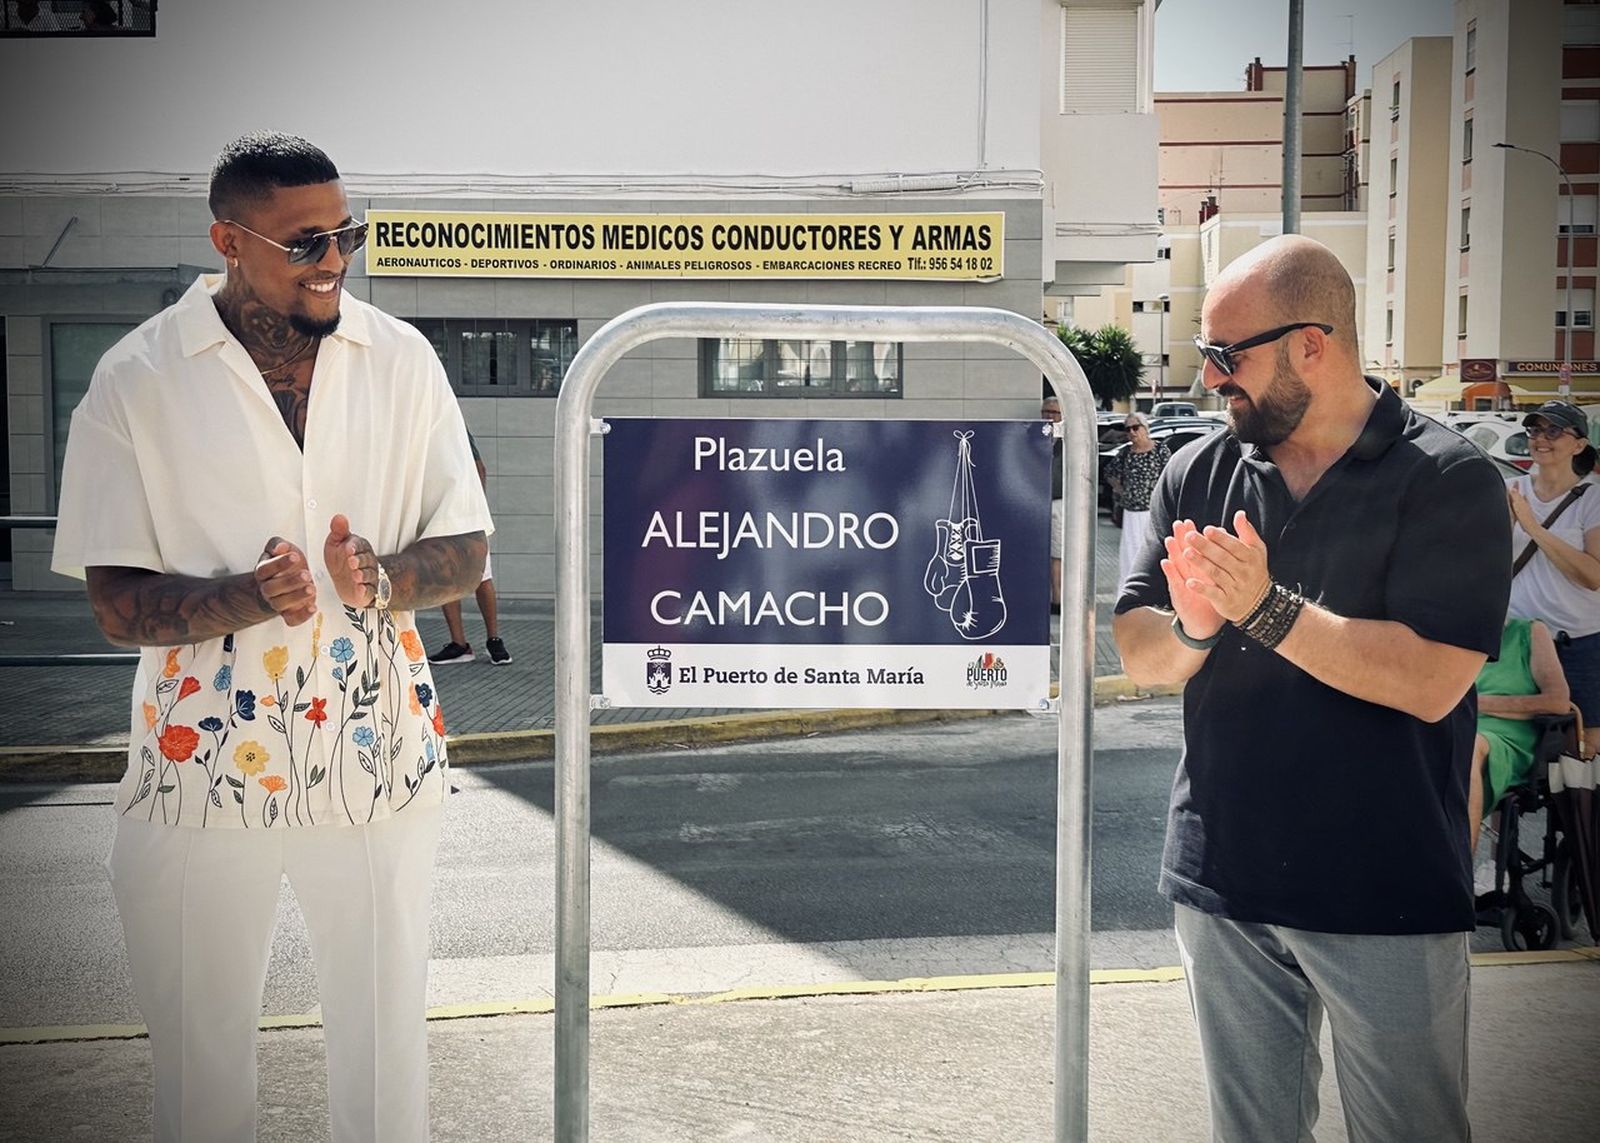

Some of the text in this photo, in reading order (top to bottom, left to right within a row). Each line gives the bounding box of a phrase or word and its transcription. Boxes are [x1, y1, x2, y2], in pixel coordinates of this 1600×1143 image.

[376, 221, 992, 251] RECONOCIMIENTOS MEDICOS CONDUCTORES Y ARMAS
[376, 257, 462, 269] AERONAUTICOS
[470, 258, 540, 270] DEPORTIVOS
[549, 259, 617, 270] ORDINARIOS
[625, 260, 682, 271] ANIMALES
[684, 260, 752, 271] PELIGROSOS
[762, 260, 855, 271] EMBARCACIONES
[858, 260, 902, 271] RECREO
[907, 256, 927, 271] Tlf.:
[928, 256, 948, 271] 956
[949, 256, 963, 271] 54
[965, 256, 978, 271] 18
[980, 256, 993, 271] 02
[1516, 362, 1598, 371] COMUNNES
[694, 437, 846, 472] Plazuela
[641, 511, 899, 560] ALEJANDRO
[650, 590, 889, 626] CAMACHO
[678, 665, 925, 685] El Puerto de Santa María
[967, 667, 1008, 682] PUERTO
